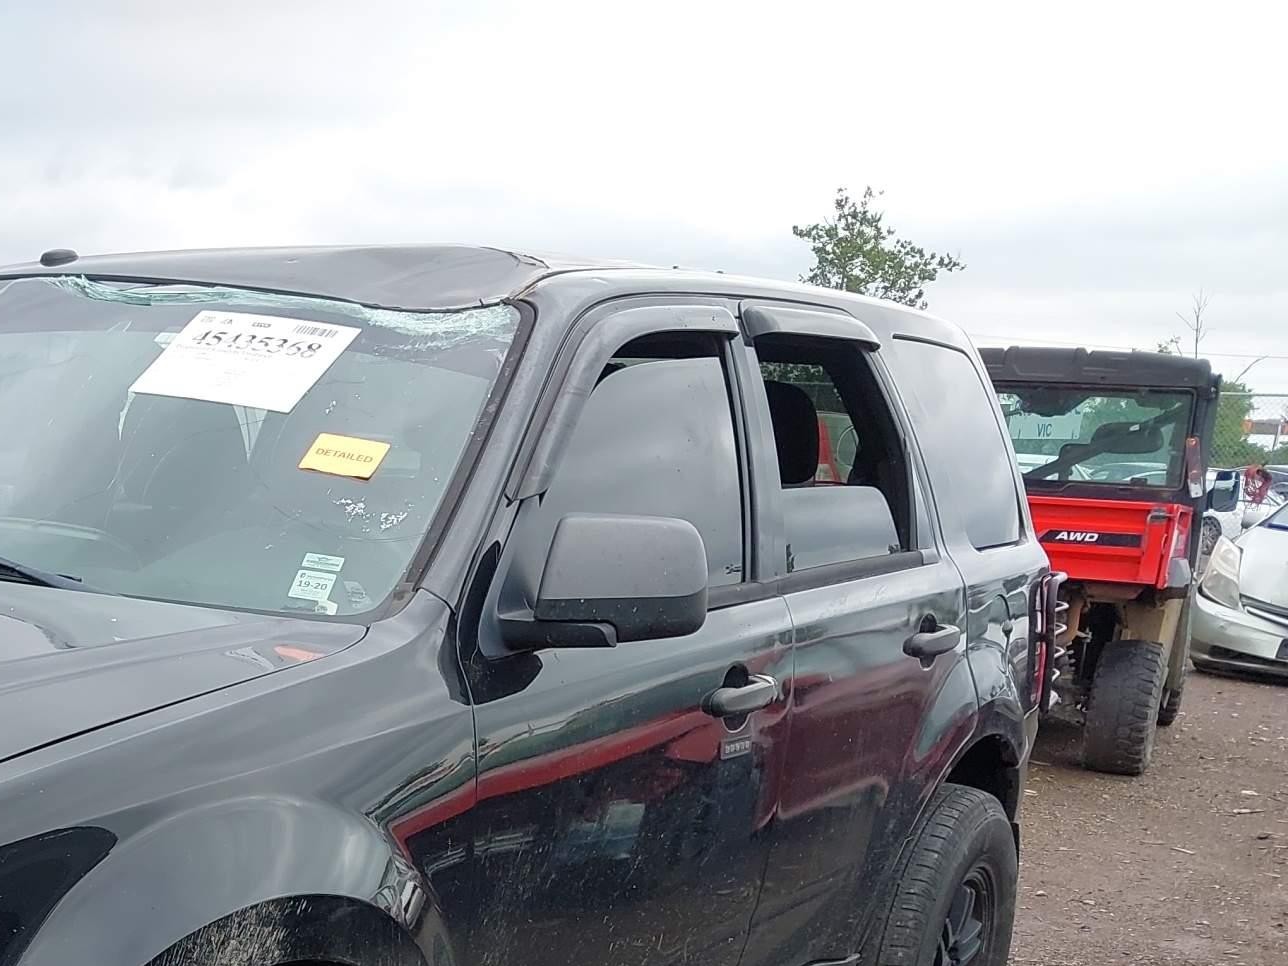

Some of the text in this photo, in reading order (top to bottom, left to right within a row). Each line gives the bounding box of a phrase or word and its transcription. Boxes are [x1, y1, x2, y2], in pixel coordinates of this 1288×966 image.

[192, 329, 323, 359] 45435368
[1037, 423, 1053, 438] VIC
[315, 448, 374, 465] DETAILED
[1055, 530, 1099, 542] AWD
[296, 580, 328, 591] 19-20
